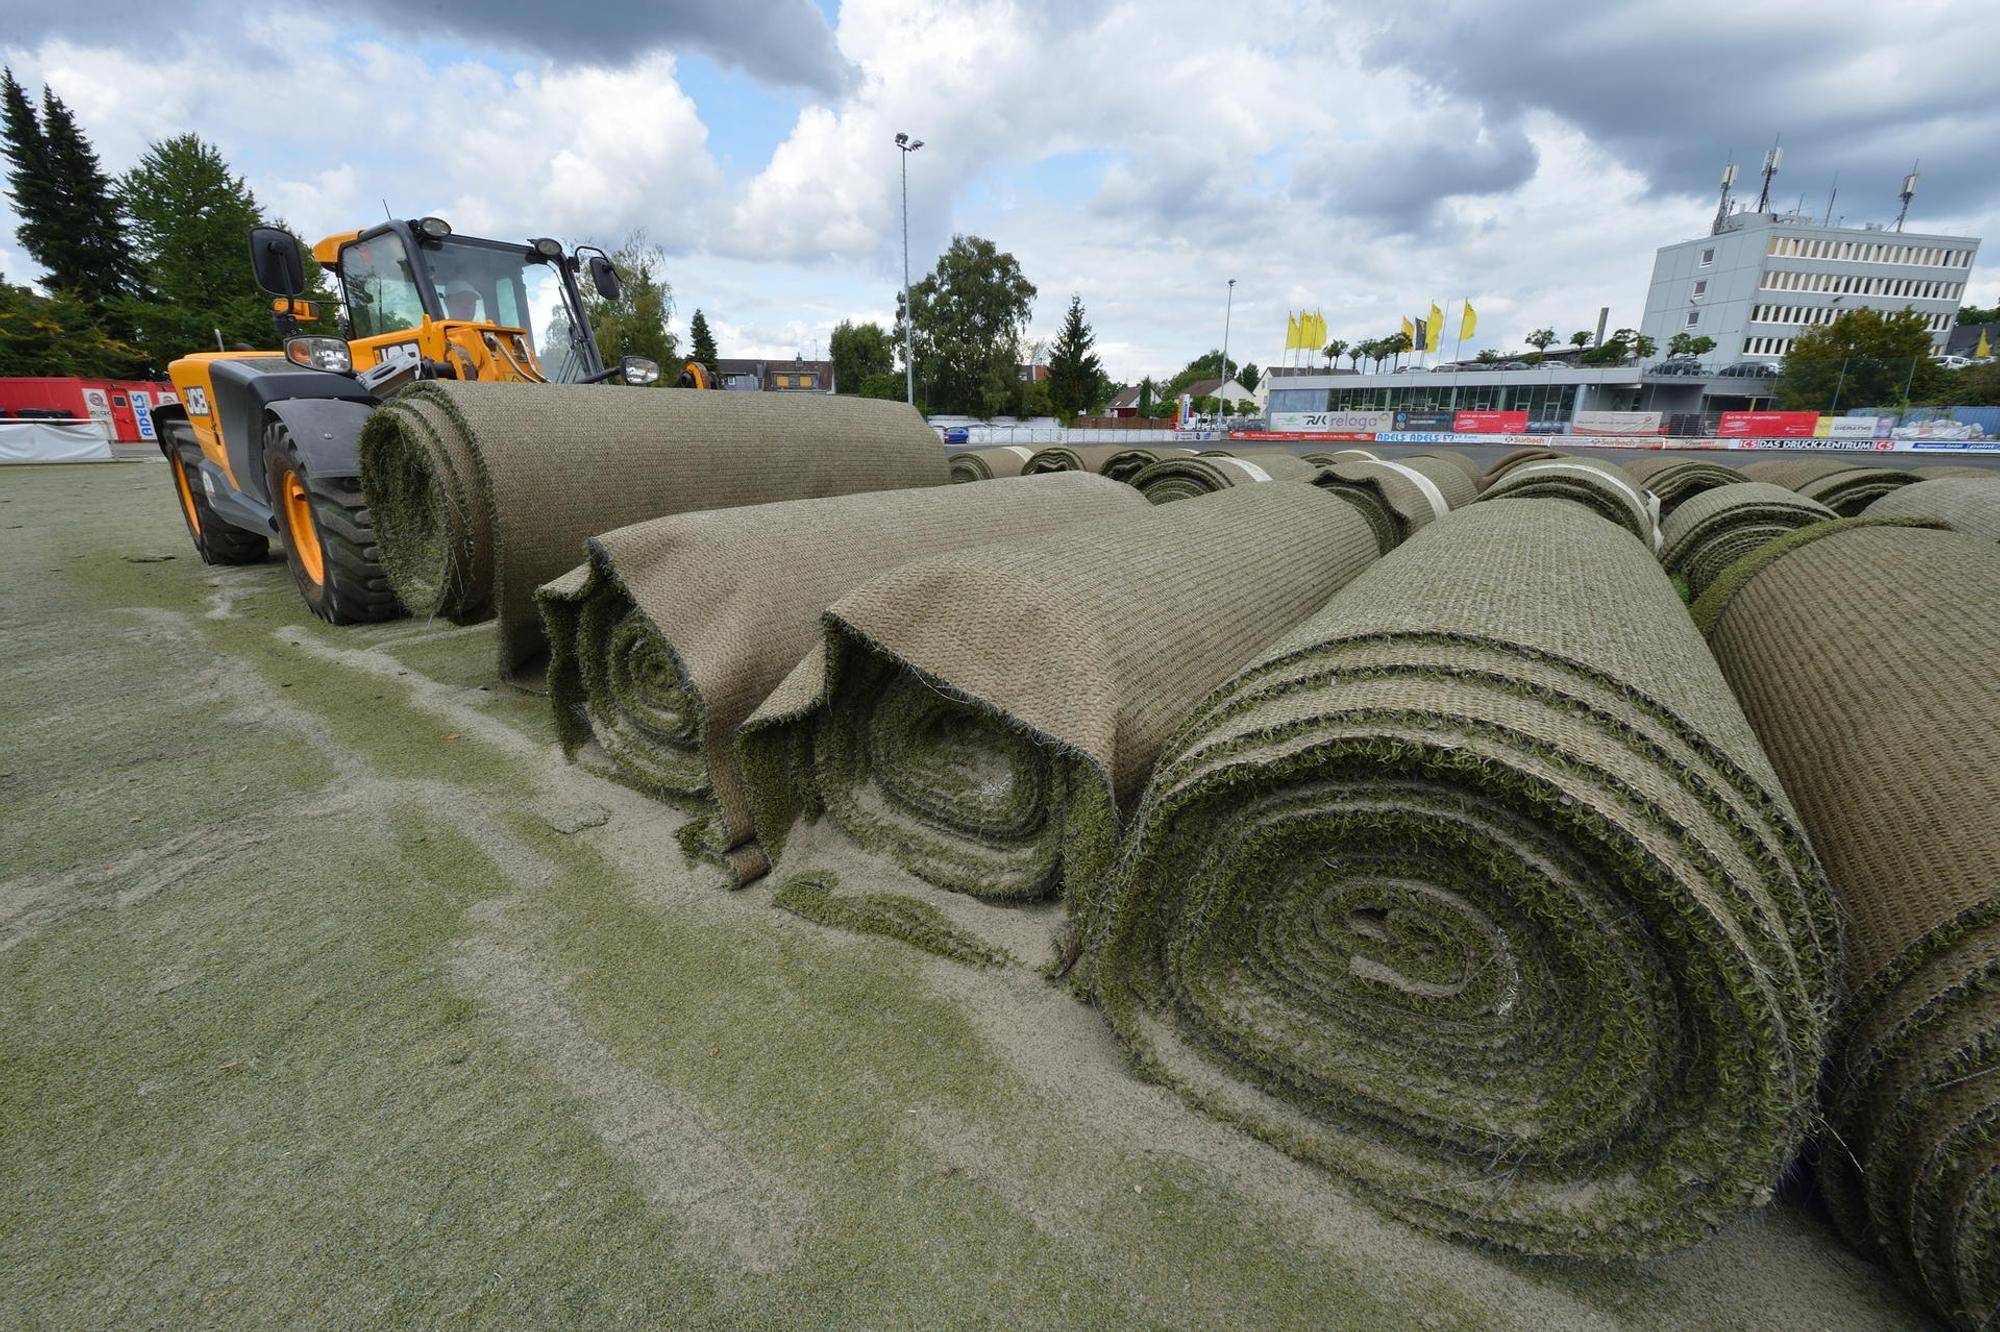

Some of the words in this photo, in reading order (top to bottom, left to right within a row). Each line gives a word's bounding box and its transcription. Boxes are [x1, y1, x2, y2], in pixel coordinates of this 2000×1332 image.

[185, 387, 209, 415] JCB
[131, 393, 154, 437] ADELS
[1376, 432, 1406, 441] ADELS
[1409, 432, 1440, 441] ADELS
[1739, 439, 1758, 448] ICS
[1759, 439, 1781, 448] DAS
[1782, 439, 1871, 449] DRUCKZENTRUM
[1873, 440, 1895, 450] ICS
